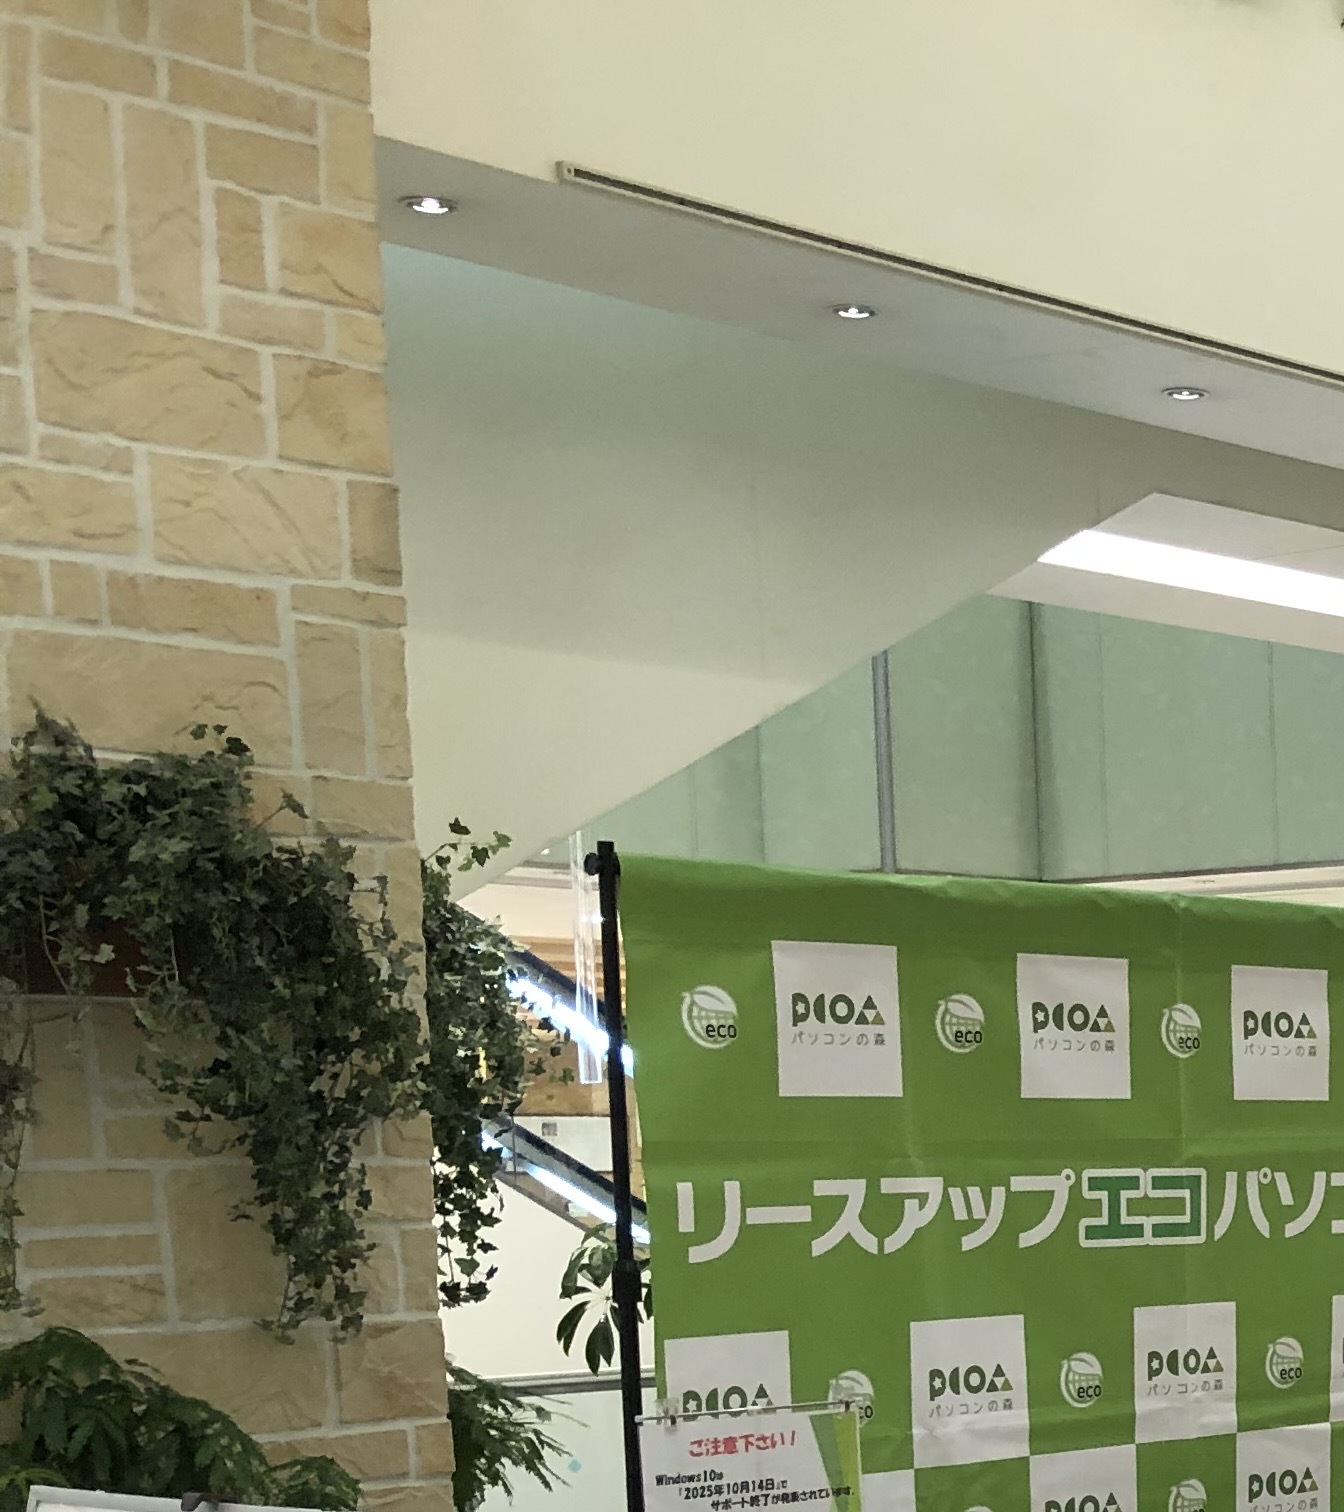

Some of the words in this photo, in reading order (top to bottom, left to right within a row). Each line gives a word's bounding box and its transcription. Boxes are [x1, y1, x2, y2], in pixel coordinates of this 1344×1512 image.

[705, 1021, 738, 1040] eco
[790, 1031, 887, 1047] パソコンの森
[953, 1027, 984, 1044] eco
[1032, 1037, 1116, 1053] パソコンの森
[1177, 1034, 1200, 1051] eco
[1243, 1042, 1318, 1058] パソコンの森
[1279, 1367, 1303, 1382] eco
[1076, 1382, 1103, 1400] eco
[1147, 1379, 1224, 1396] パソコンの森
[858, 1404, 874, 1420] co
[928, 1399, 1014, 1419] パソコンの森
